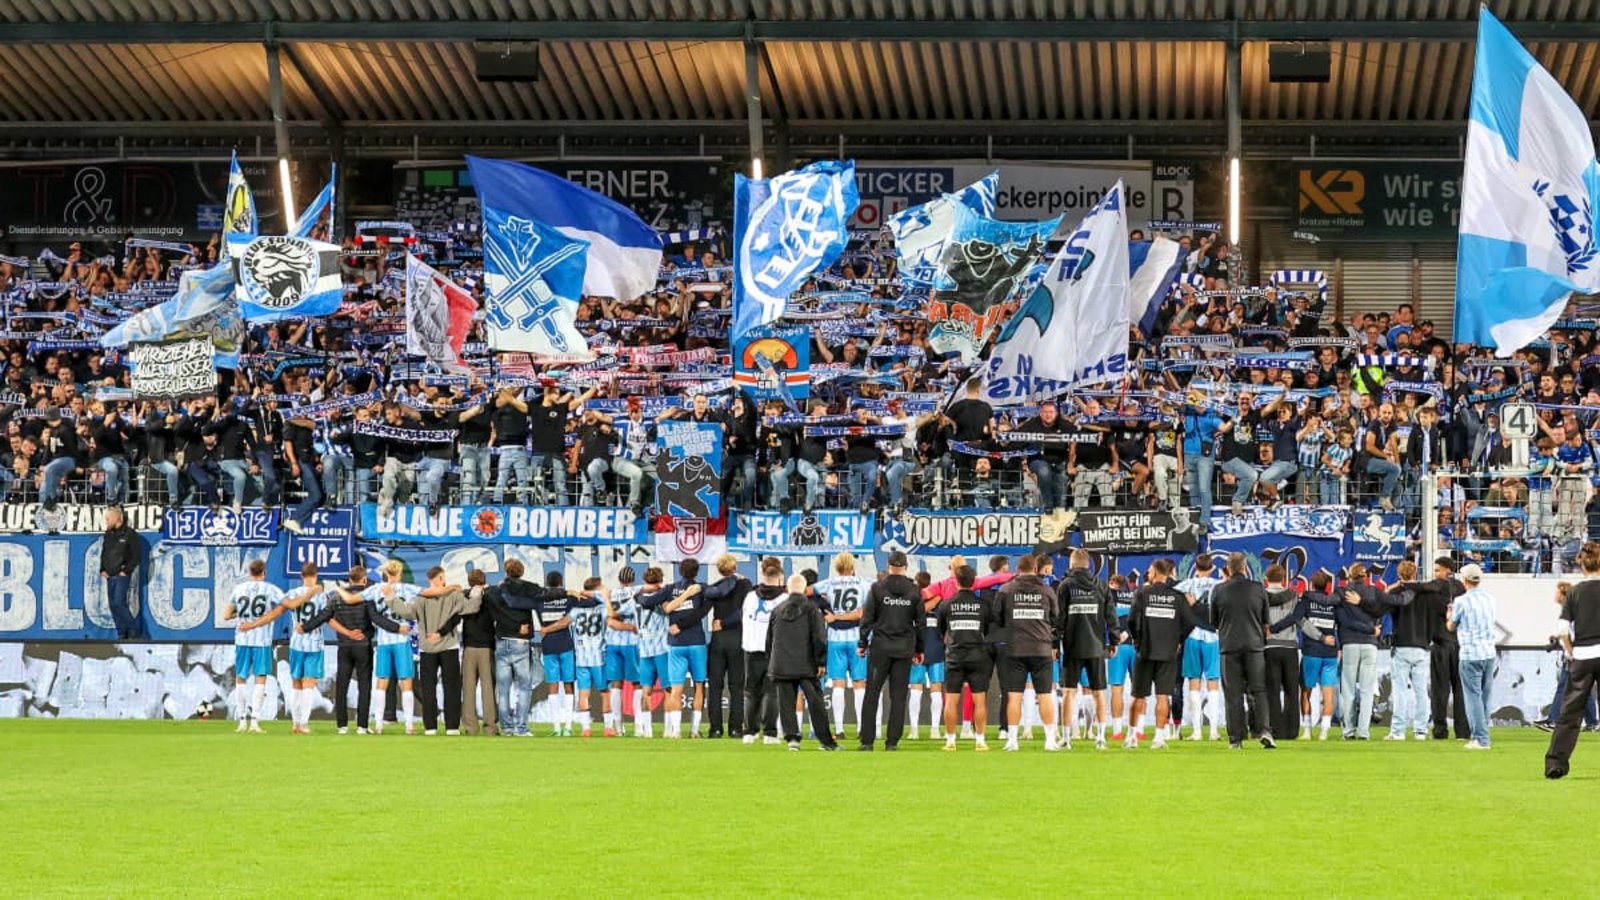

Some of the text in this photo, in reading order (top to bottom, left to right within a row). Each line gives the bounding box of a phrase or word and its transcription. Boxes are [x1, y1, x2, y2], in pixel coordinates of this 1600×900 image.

[858, 172, 944, 194] TICKER
[1156, 166, 1191, 176] BLOCK
[63, 166, 114, 223] &
[1383, 173, 1434, 199] Wir
[1383, 202, 1434, 226] wie
[1235, 358, 1290, 369] BLOCK
[1508, 406, 1529, 433] 4
[0, 503, 162, 532] LUE FANTIC
[166, 509, 272, 541] 13 12
[311, 512, 329, 525] FC
[376, 505, 636, 540] BLAUE BOMBER
[1096, 513, 1151, 528] LUCA FÜR
[1255, 507, 1301, 520] BLUE
[736, 515, 868, 546] SEK SV
[903, 514, 1040, 545] YOUNG CARE
[1083, 528, 1121, 543] IMMER
[1143, 526, 1166, 540] UNS
[1212, 517, 1302, 535] SHARKS
[298, 543, 341, 568] LINZ
[237, 595, 267, 619] 26
[832, 587, 859, 612] 16
[960, 603, 981, 612] MHP
[1023, 593, 1043, 602] MHP
[575, 612, 602, 638] 38
